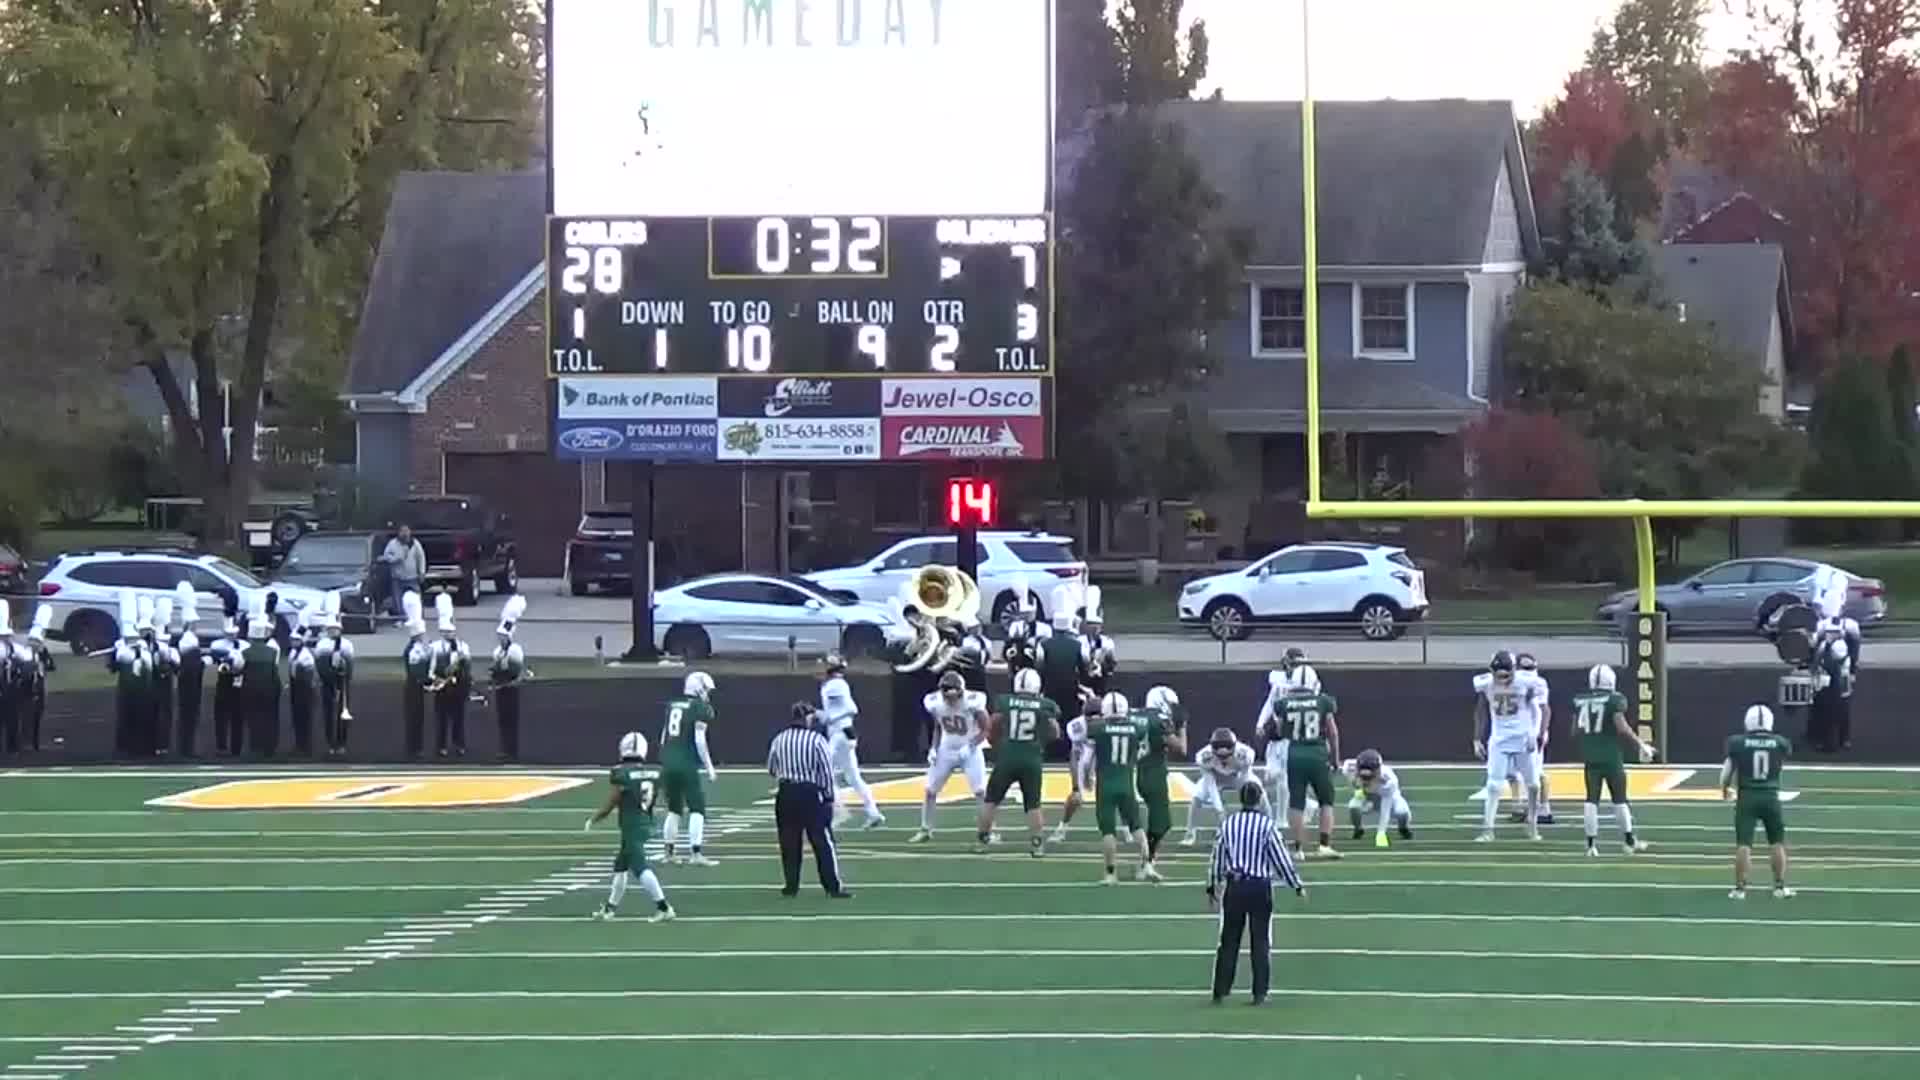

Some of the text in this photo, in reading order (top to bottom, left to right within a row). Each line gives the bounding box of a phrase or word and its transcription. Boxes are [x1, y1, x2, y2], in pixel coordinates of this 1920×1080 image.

[756, 217, 881, 273] 0:32
[562, 247, 622, 293] 28
[1010, 245, 1036, 287] 7
[574, 308, 584, 338] 1
[621, 302, 684, 324] DOWN
[710, 302, 771, 324] TO GO
[818, 302, 893, 323] BALL ON
[924, 302, 964, 323] QTR
[1017, 304, 1037, 340] 3
[553, 349, 603, 371] T.O.L.
[656, 328, 667, 367] 1
[728, 325, 771, 371] 10
[858, 325, 886, 367] 9
[931, 325, 959, 371] 2
[996, 348, 1046, 370] T.O.L.
[586, 392, 715, 406] Bank of Pontiac
[884, 387, 1034, 408] Jewel-Osco
[571, 432, 610, 448] Ford
[685, 424, 717, 437] FORD
[901, 426, 991, 443] CARDINAL
[951, 483, 991, 523] 14
[669, 708, 682, 737] 8
[1010, 709, 1036, 741] 12
[1287, 711, 1320, 741] 78
[1111, 735, 1129, 765] 11
[1753, 750, 1769, 780] 0
